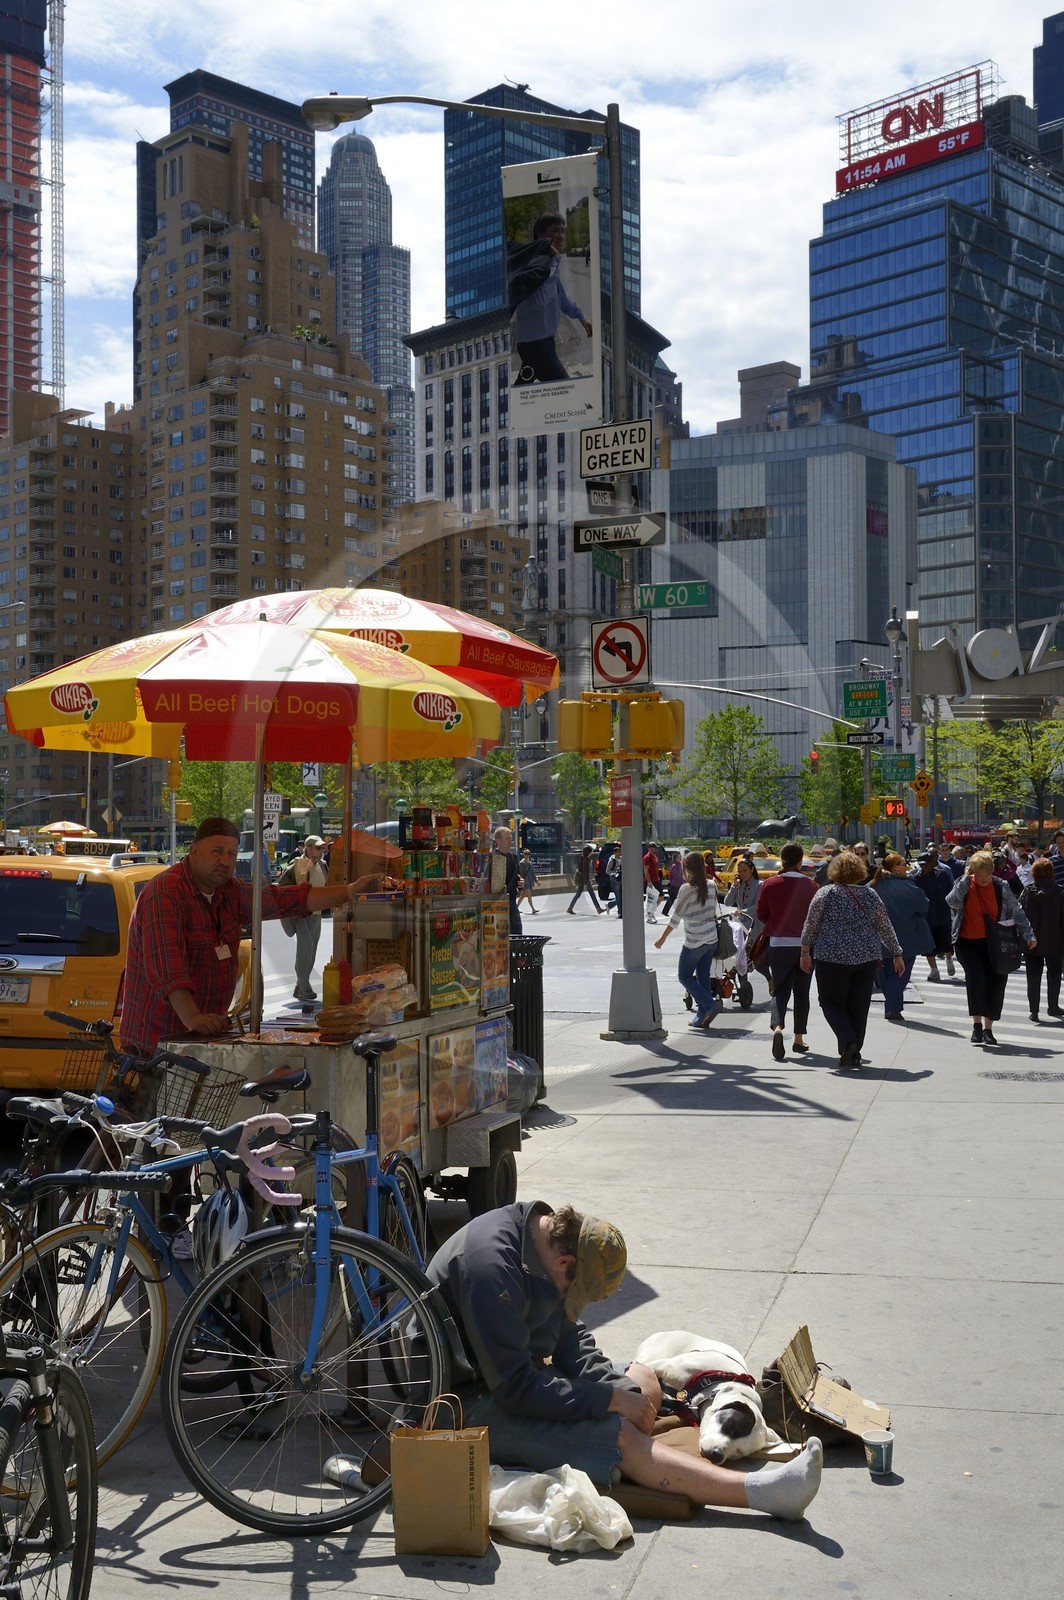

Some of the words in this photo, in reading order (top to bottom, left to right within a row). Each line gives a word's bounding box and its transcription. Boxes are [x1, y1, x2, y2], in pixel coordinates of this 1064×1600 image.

[881, 92, 944, 143] CNN
[938, 132, 970, 153] 55°F
[845, 165, 880, 184] 11:54
[884, 154, 906, 170] AM
[585, 427, 647, 451] DELAYED
[587, 447, 645, 471] GREEN
[593, 491, 609, 505] ONE
[584, 528, 609, 542] ONE
[613, 525, 639, 540] WAY
[642, 587, 656, 606] W
[665, 586, 689, 606] 60
[696, 585, 706, 595] ST
[353, 630, 397, 649] NIKAS
[467, 645, 480, 661] All
[483, 648, 505, 666] Beef
[507, 653, 552, 678] Sausages
[54, 685, 88, 710] NIKAS
[848, 683, 880, 691] BROADWAY
[852, 691, 877, 699] CLOSED
[155, 693, 181, 712] All
[189, 693, 237, 713] Beef
[244, 695, 280, 714] Hot
[287, 695, 340, 720] Dogs
[418, 695, 453, 717] NIKAS
[83, 842, 110, 855] 8D97
[431, 945, 452, 963] Pretzel
[431, 968, 456, 985] Sausage
